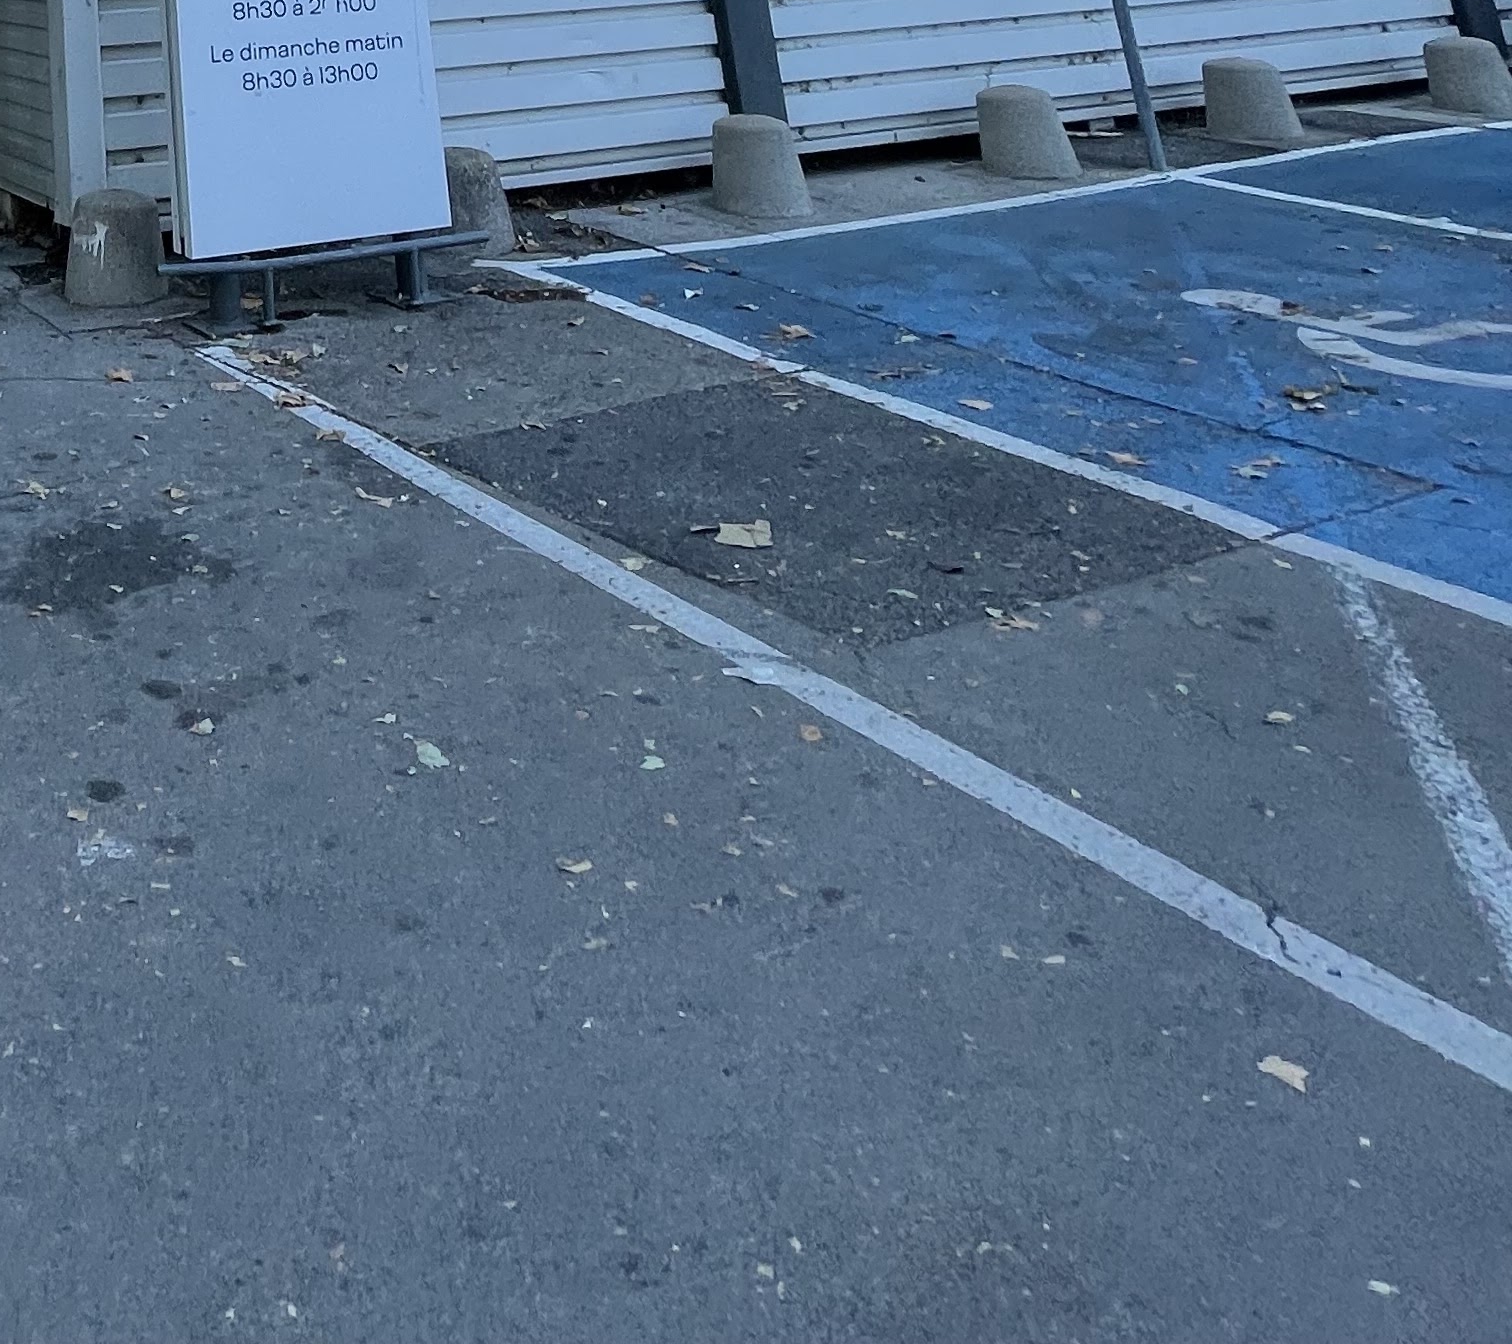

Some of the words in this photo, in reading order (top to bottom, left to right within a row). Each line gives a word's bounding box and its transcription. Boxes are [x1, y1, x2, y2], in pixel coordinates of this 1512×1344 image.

[232, 0, 287, 21] 8h30
[210, 45, 234, 63] Le
[240, 37, 340, 62] dimanche
[345, 32, 403, 53] matin
[242, 69, 297, 91] 8h30
[303, 66, 314, 86] à
[319, 62, 378, 85] 13h00
